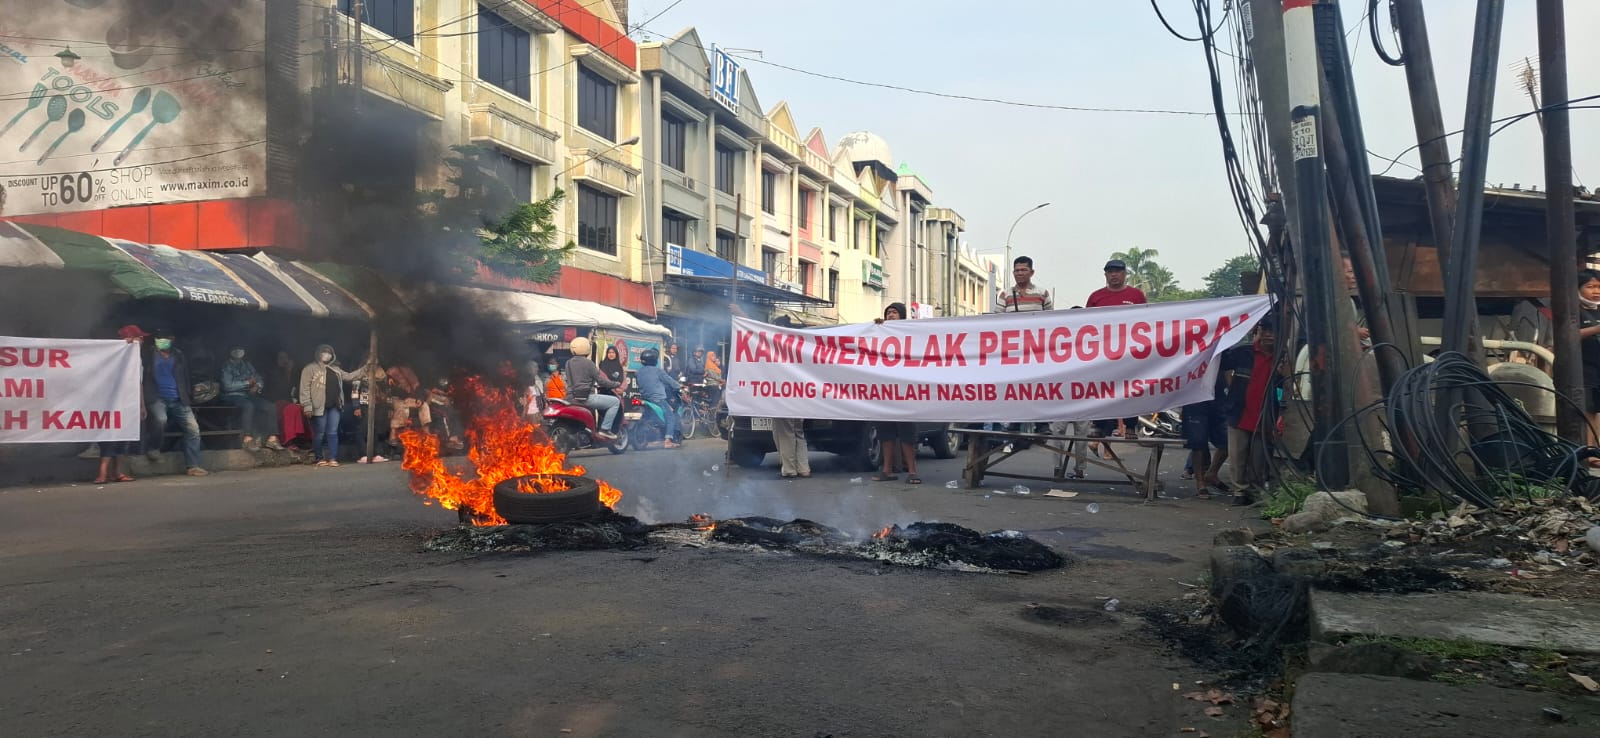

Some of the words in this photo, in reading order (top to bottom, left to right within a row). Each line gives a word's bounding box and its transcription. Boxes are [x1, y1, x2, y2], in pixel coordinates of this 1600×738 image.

[716, 53, 739, 99] BFI
[41, 66, 119, 120] TOOLS
[715, 90, 738, 114] FINANCE
[8, 178, 37, 188] DISCOUNT
[41, 176, 58, 190] UP
[111, 167, 152, 184] SHOP
[160, 177, 248, 191] www.maxim.co.id
[41, 192, 58, 207] TO
[94, 194, 106, 202] OFF
[111, 187, 153, 201] ONLINE
[0, 346, 71, 368] SUR
[735, 330, 804, 364] KAMI
[812, 332, 968, 369] MENOLAK
[751, 381, 816, 399] TOLONG
[822, 382, 930, 401] PIKIRANLAH
[937, 383, 997, 401] NASIB
[1005, 382, 1063, 401] ANAK
[1071, 381, 1116, 400] DAN
[1124, 375, 1181, 399] ISTRI
[42, 410, 121, 430] KAMI
